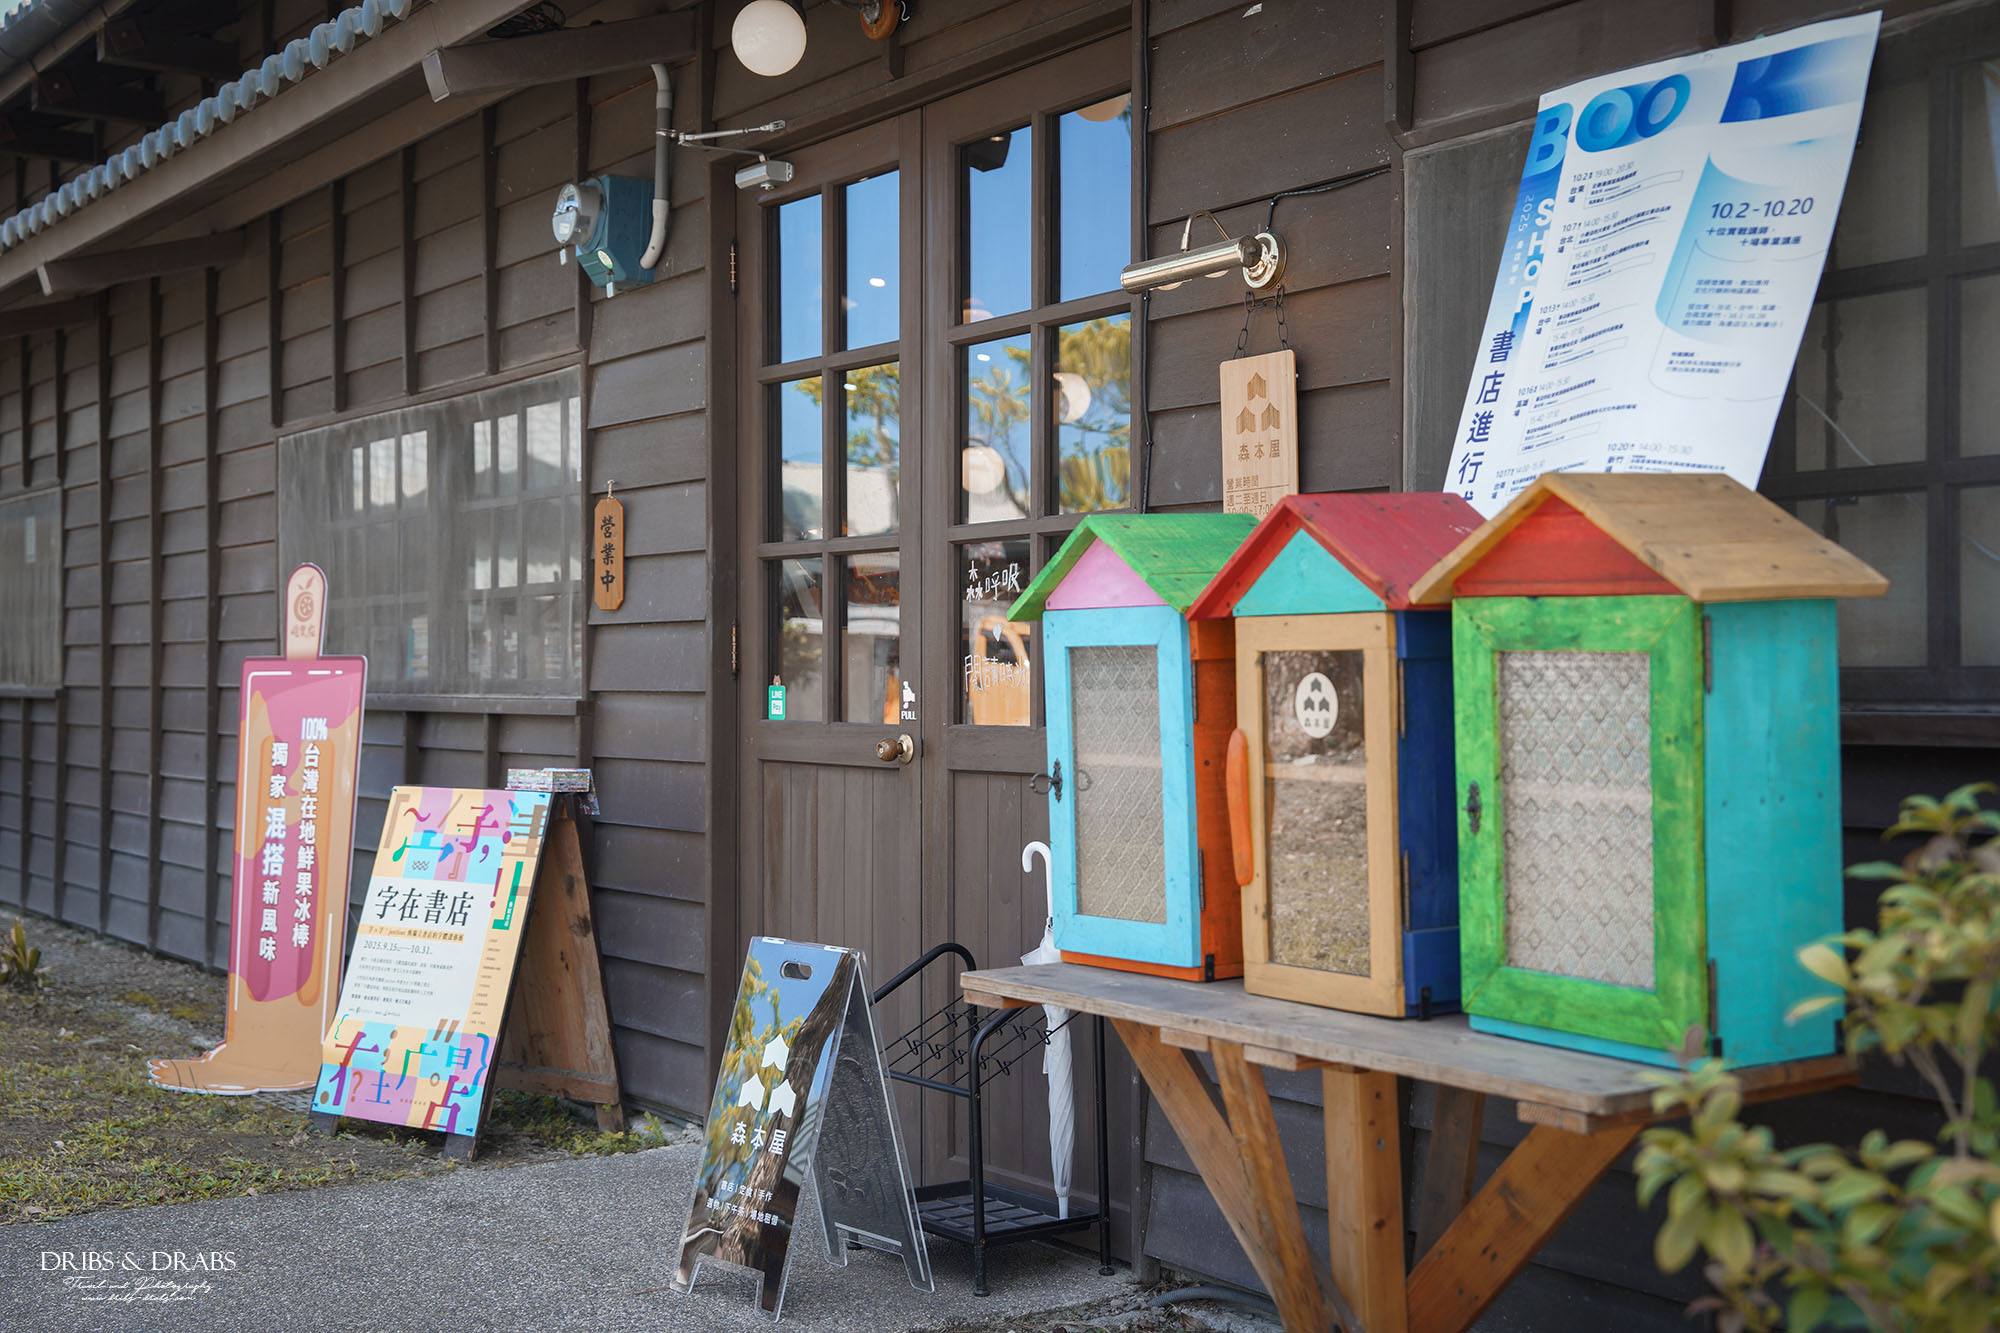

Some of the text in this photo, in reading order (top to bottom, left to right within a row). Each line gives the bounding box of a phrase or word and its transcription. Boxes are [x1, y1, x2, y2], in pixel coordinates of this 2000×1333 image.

[1226, 475, 1259, 490] 營業時間
[600, 515, 616, 593] 營業中
[771, 690, 783, 699] LINE
[901, 711, 917, 720] PULL
[301, 718, 328, 741] 100%
[292, 743, 320, 949] 台灣在地鮮果冰棒
[375, 885, 475, 927] 字在書店
